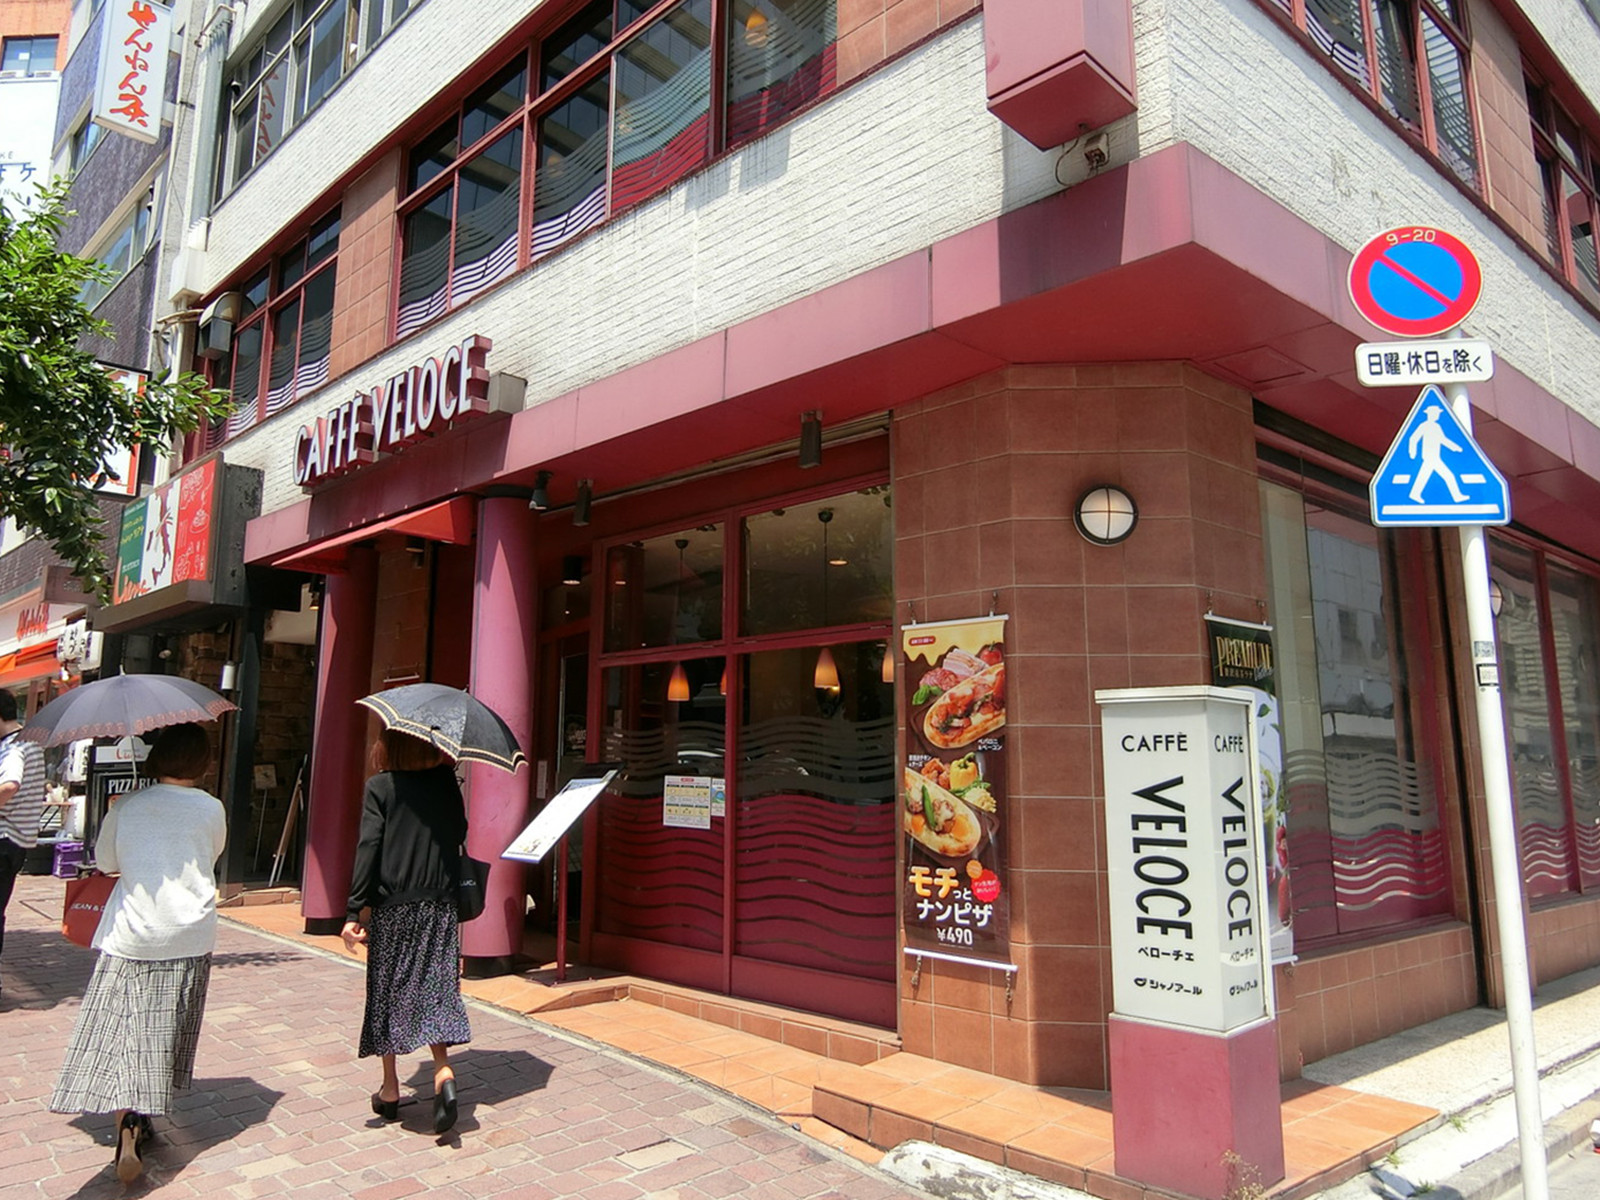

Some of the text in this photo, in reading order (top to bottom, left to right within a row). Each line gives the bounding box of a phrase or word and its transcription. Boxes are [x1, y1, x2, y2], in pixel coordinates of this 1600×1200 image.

[1386, 229, 1436, 246] 9-20
[1368, 349, 1483, 376] 日曜・休日を除く
[371, 334, 491, 452] VELOCE
[1131, 775, 1193, 940] VELOCE
[1221, 776, 1253, 940] VELOCE
[909, 866, 973, 900] モチっと
[916, 899, 993, 927] ナンピザ
[936, 926, 973, 945] ¥490
[1138, 946, 1195, 961] ベローチェ
[1149, 978, 1203, 996] シャノアール
